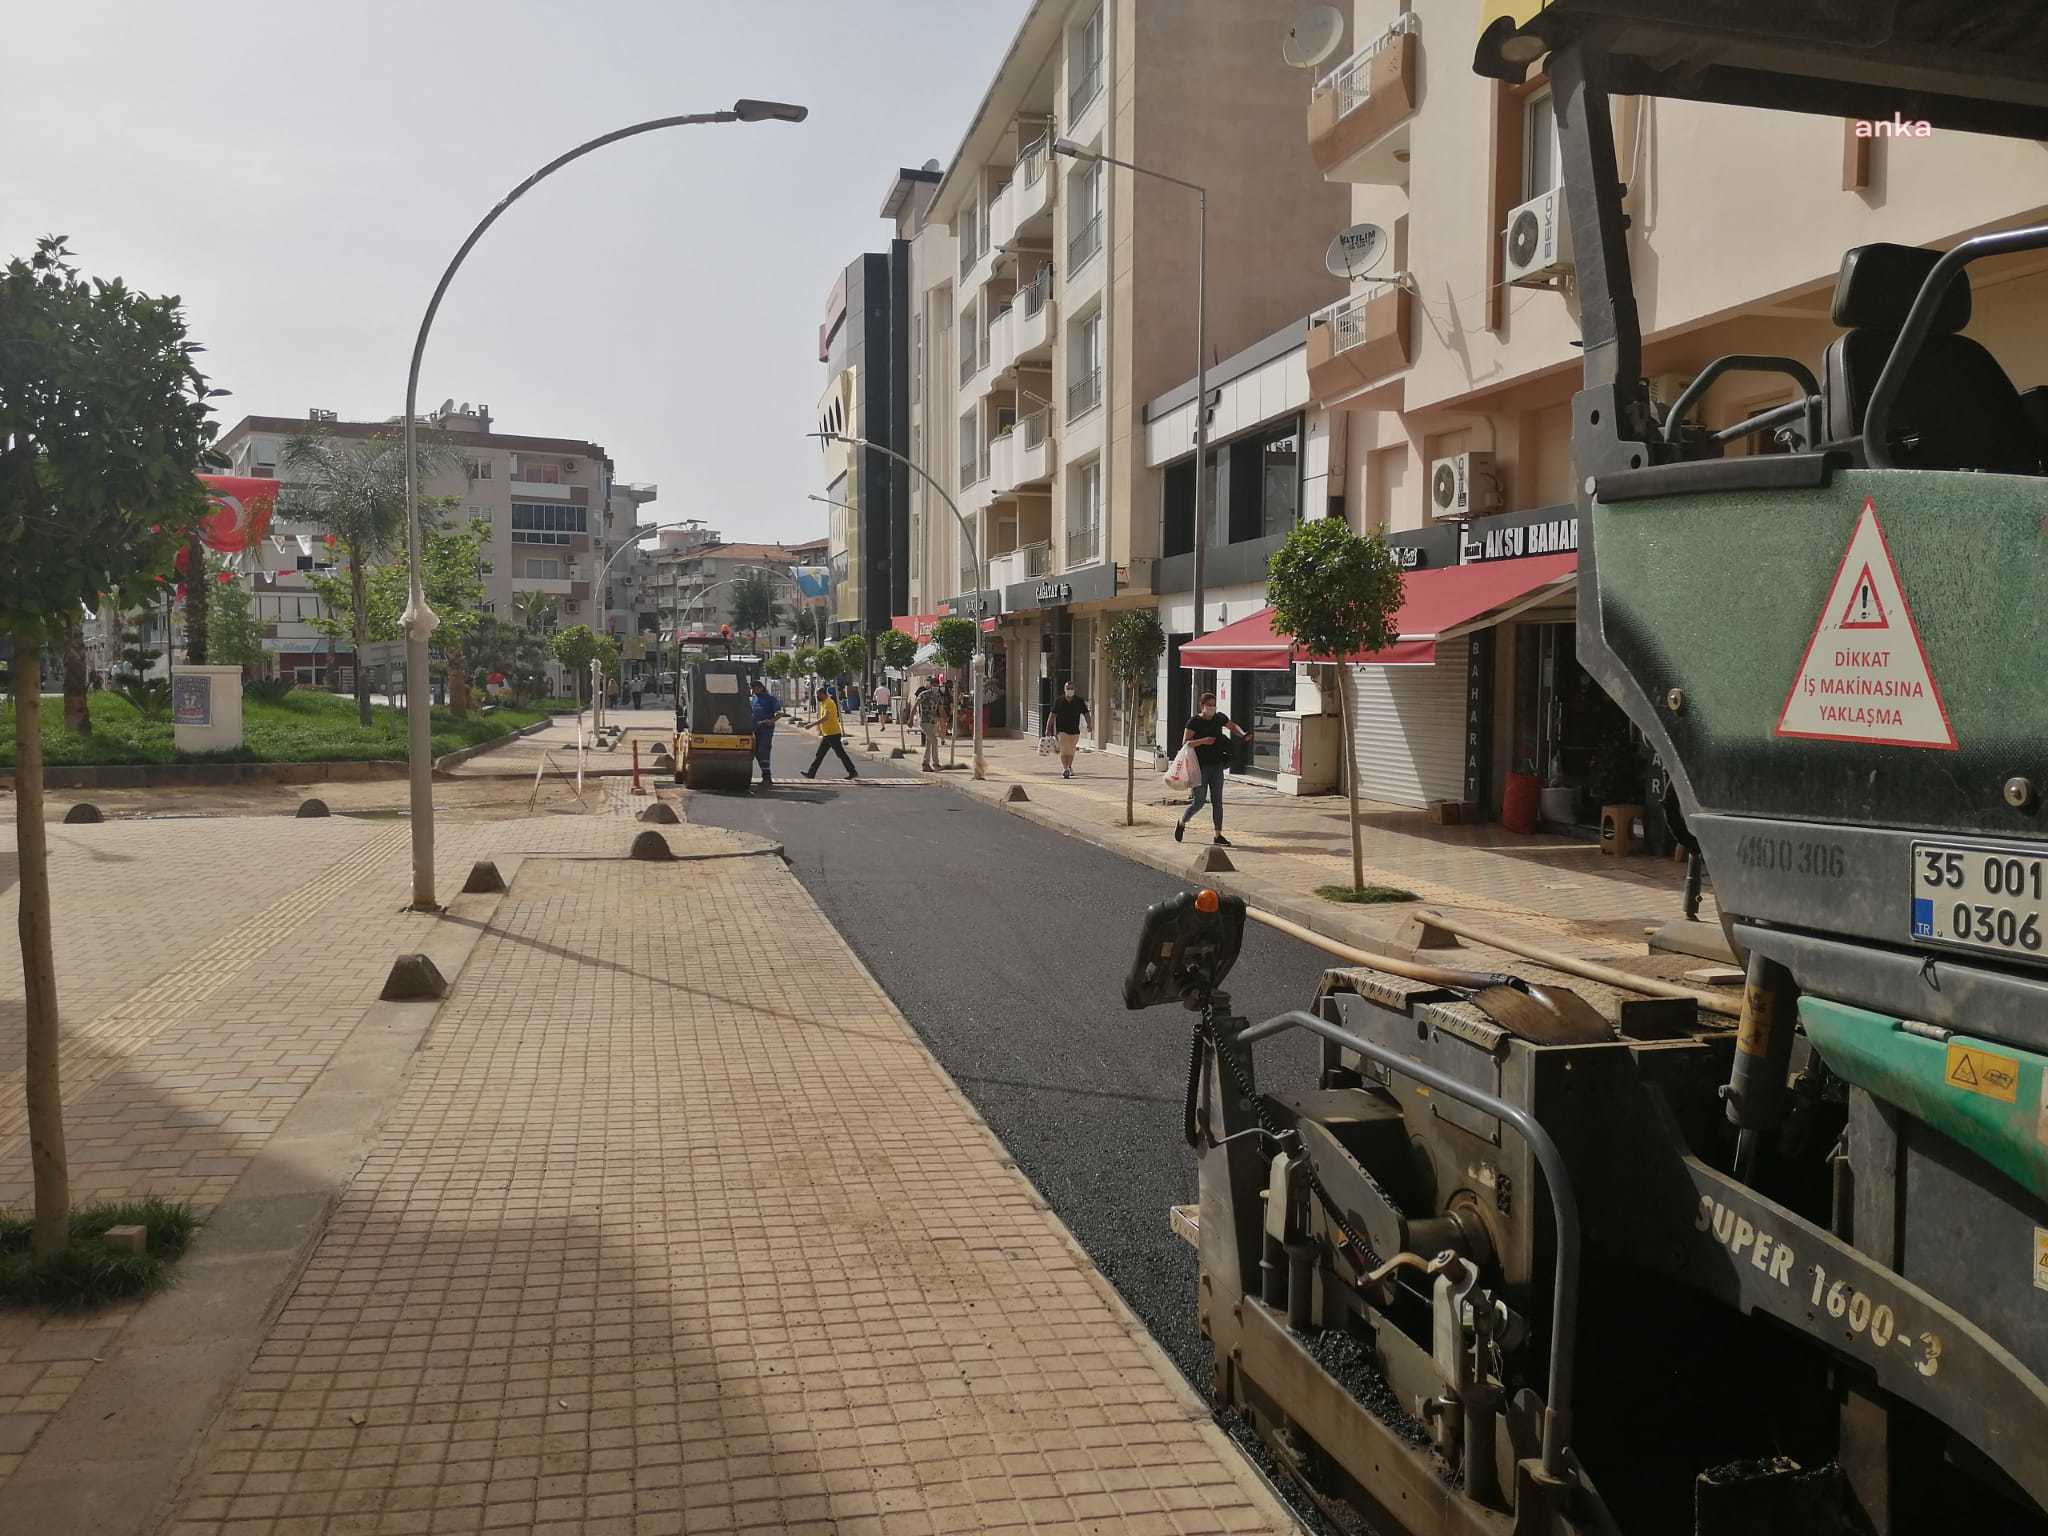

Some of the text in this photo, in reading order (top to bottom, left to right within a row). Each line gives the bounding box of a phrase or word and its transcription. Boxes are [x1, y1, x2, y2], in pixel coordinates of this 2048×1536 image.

[1544, 195, 1553, 259] BEKO
[1485, 518, 1578, 558] AKSU BAHAR
[1834, 648, 1891, 668] DİKKAT
[1804, 674, 1924, 698] İŞ MAKİNASINA
[1468, 642, 1480, 790] BAHARAT
[1819, 704, 1903, 727] YAKLAŞMA
[1922, 850, 2042, 900] 35 001
[1916, 922, 1930, 935] TR
[1953, 902, 2042, 950] 0306
[1695, 1194, 1942, 1377] SUPER 1600-3
